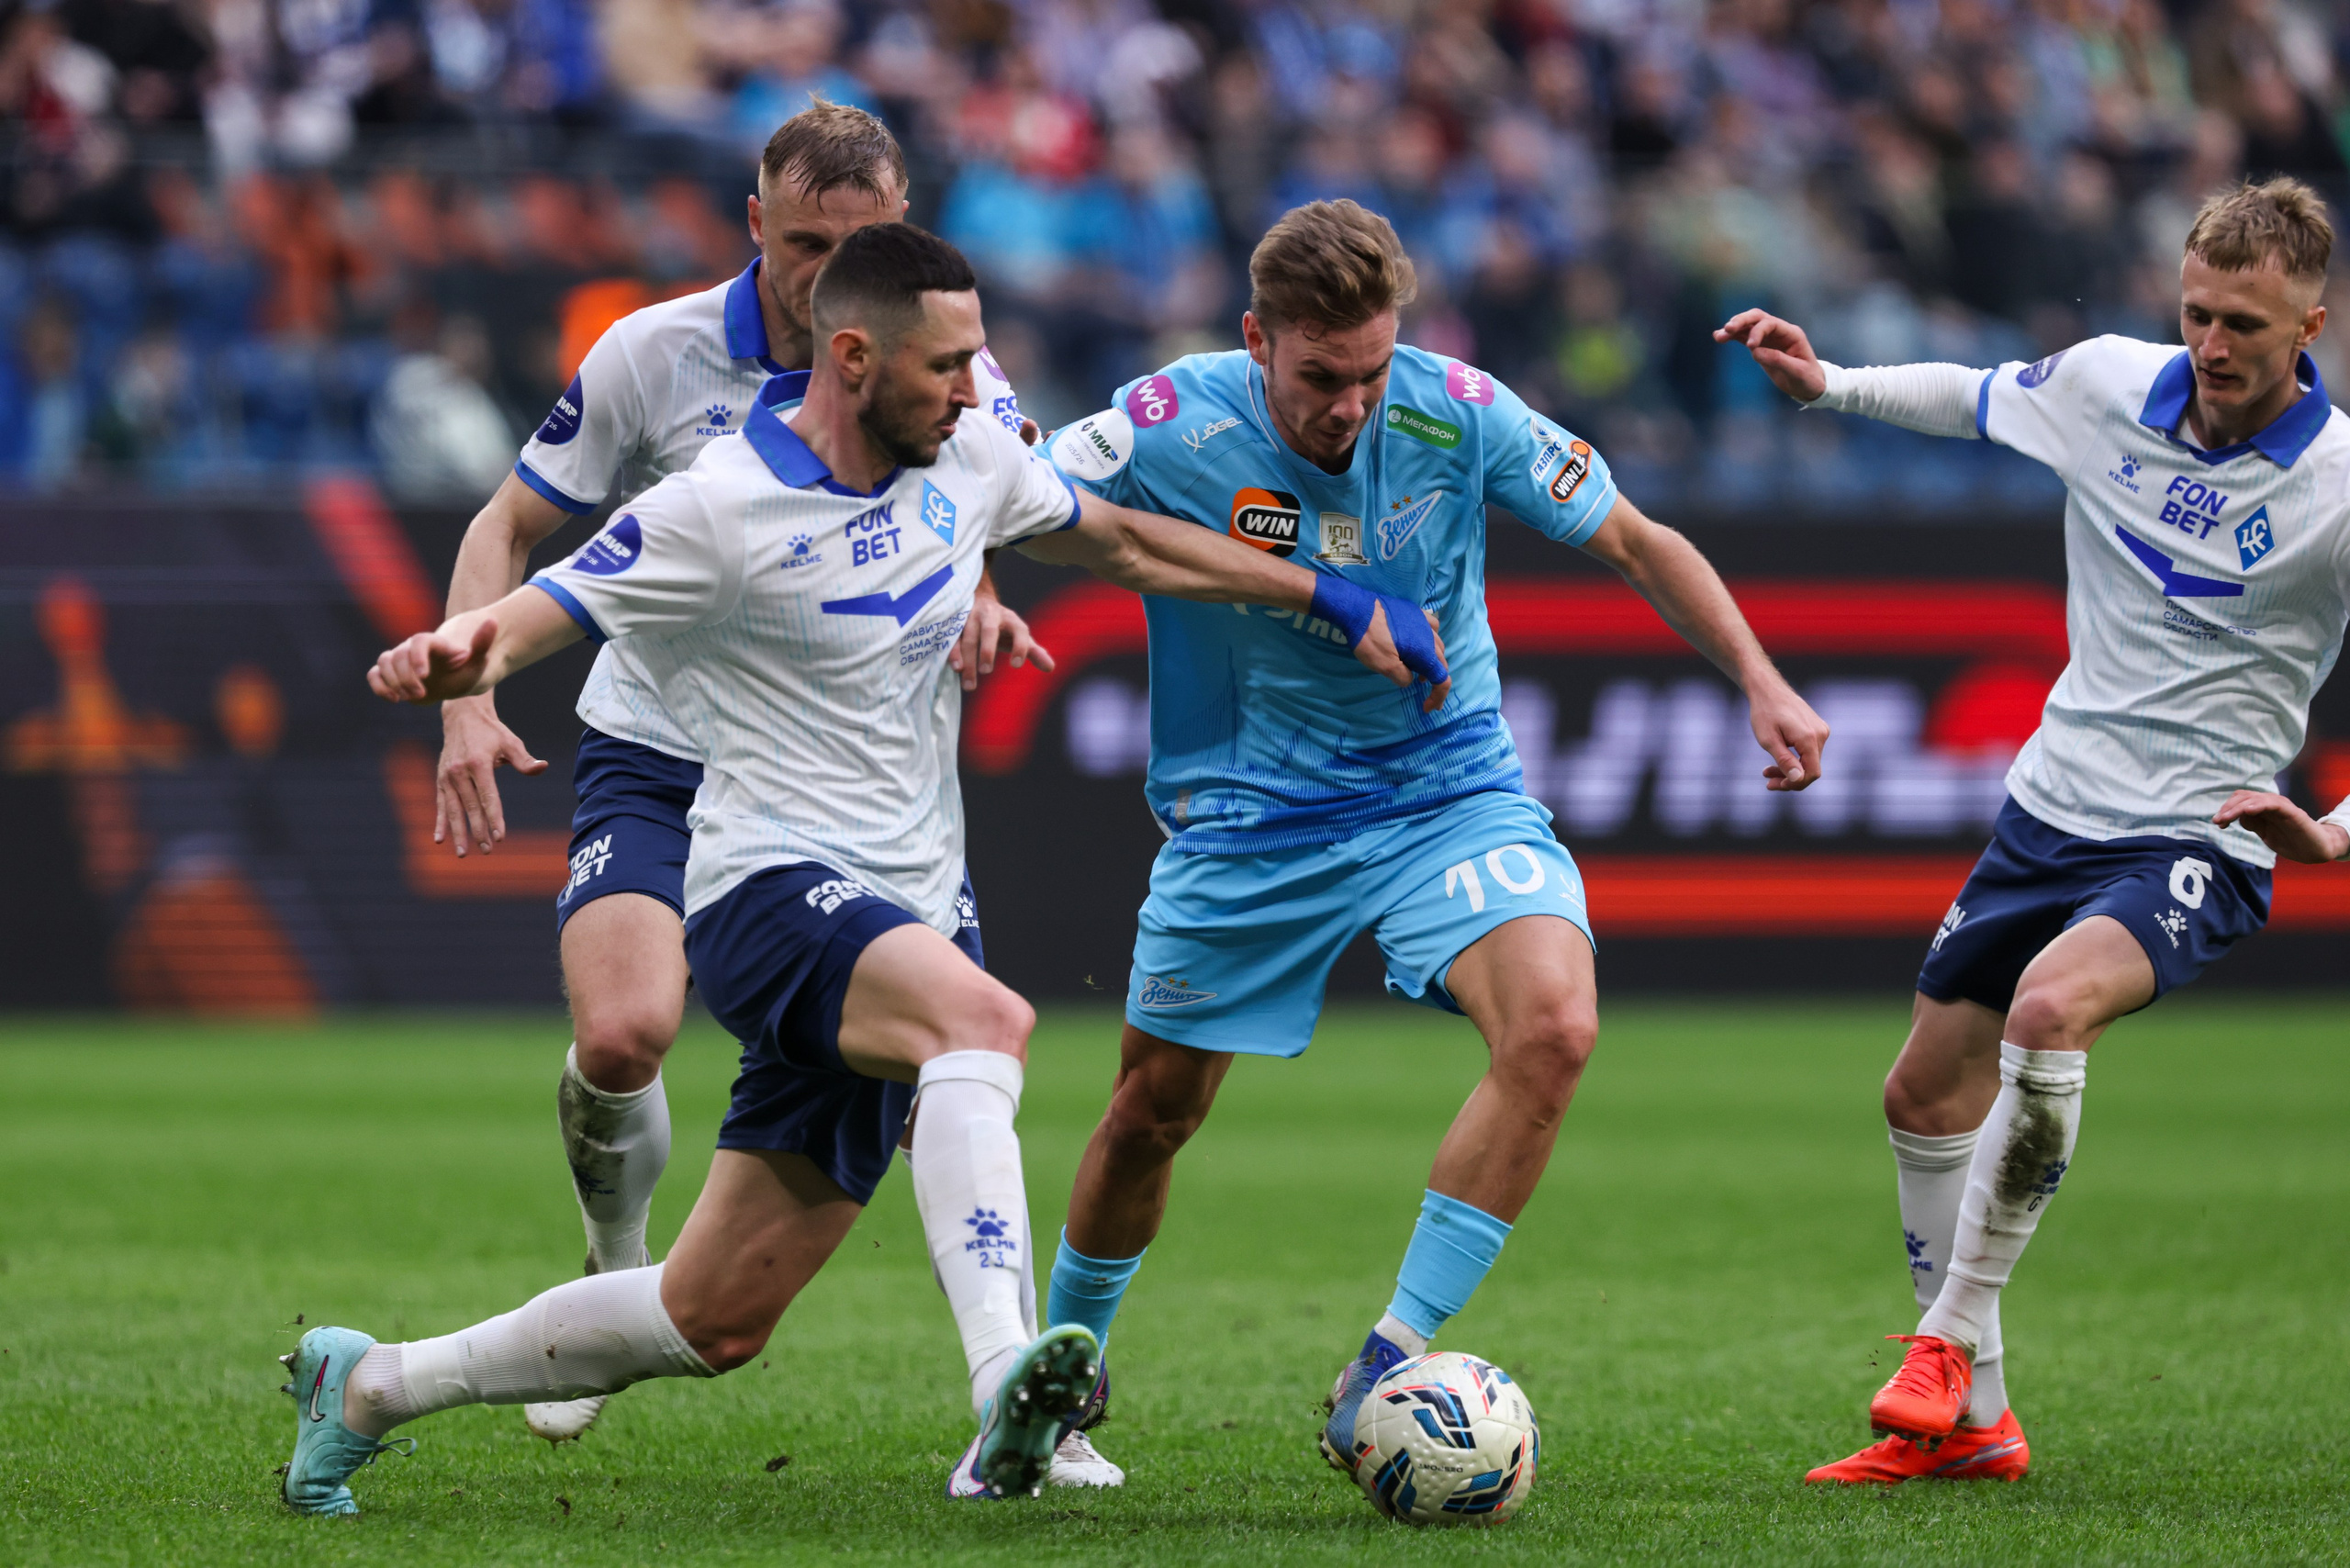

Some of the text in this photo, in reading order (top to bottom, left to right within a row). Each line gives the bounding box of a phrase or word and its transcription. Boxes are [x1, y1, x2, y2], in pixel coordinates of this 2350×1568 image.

[1458, 367, 1482, 398] wb
[1137, 380, 1169, 420] wb
[1089, 429, 1119, 462] МИР
[1201, 417, 1244, 441] JÖGEL
[2108, 469, 2141, 494] KELME
[2165, 475, 2228, 516] FON
[845, 498, 895, 538] FON
[1245, 512, 1295, 537] WIN
[2158, 501, 2221, 540] BET
[780, 554, 822, 570] KELME
[852, 527, 901, 567] BET
[2163, 622, 2218, 642] ОБЛАСТИ
[1446, 842, 1545, 913] 10
[2168, 856, 2213, 910] 6
[2154, 913, 2180, 949] KELME
[965, 1238, 1017, 1252] KELME
[979, 1251, 1005, 1269] 23
